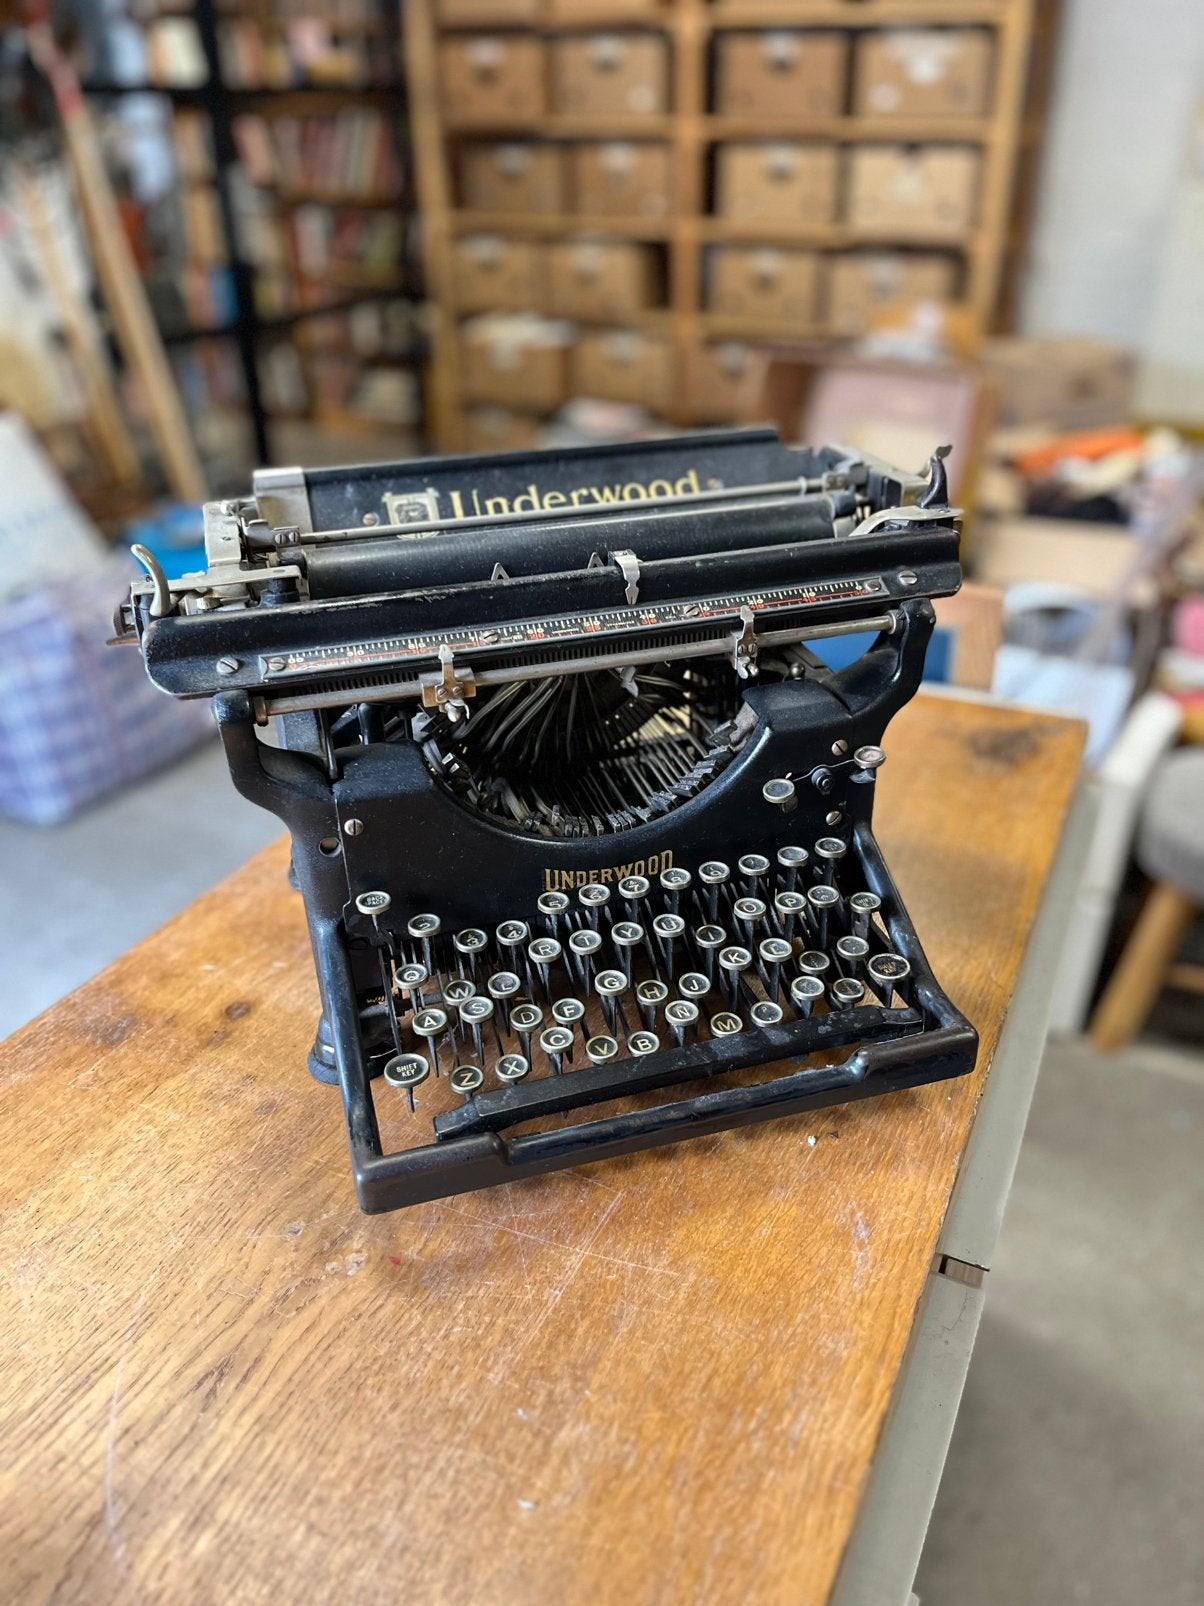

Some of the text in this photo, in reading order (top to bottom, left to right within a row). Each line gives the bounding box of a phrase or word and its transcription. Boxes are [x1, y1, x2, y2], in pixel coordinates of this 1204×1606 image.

[450, 469, 700, 520] Underwood
[545, 850, 673, 892] UNDERWOOD
[743, 902, 757, 913] O
[784, 898, 797, 907] P
[661, 919, 677, 931] U
[620, 927, 633, 938] Y
[578, 935, 591, 946] T
[538, 944, 553, 955] R
[728, 952, 742, 964] K
[403, 970, 420, 981] Q
[604, 977, 620, 988] G
[689, 979, 699, 991] J
[448, 986, 469, 999] W
[645, 987, 660, 998] H
[472, 1002, 486, 1014] S
[562, 1005, 575, 1018] F
[677, 1006, 690, 1018] N
[424, 1016, 437, 1028] A
[520, 1011, 535, 1024] D
[717, 1018, 737, 1032] M
[549, 1033, 566, 1045] C
[637, 1038, 652, 1051] B
[594, 1042, 608, 1055] V
[396, 1062, 418, 1073] SHIFT
[401, 1068, 416, 1078] KEY
[504, 1060, 521, 1075] X
[460, 1072, 477, 1087] Z
